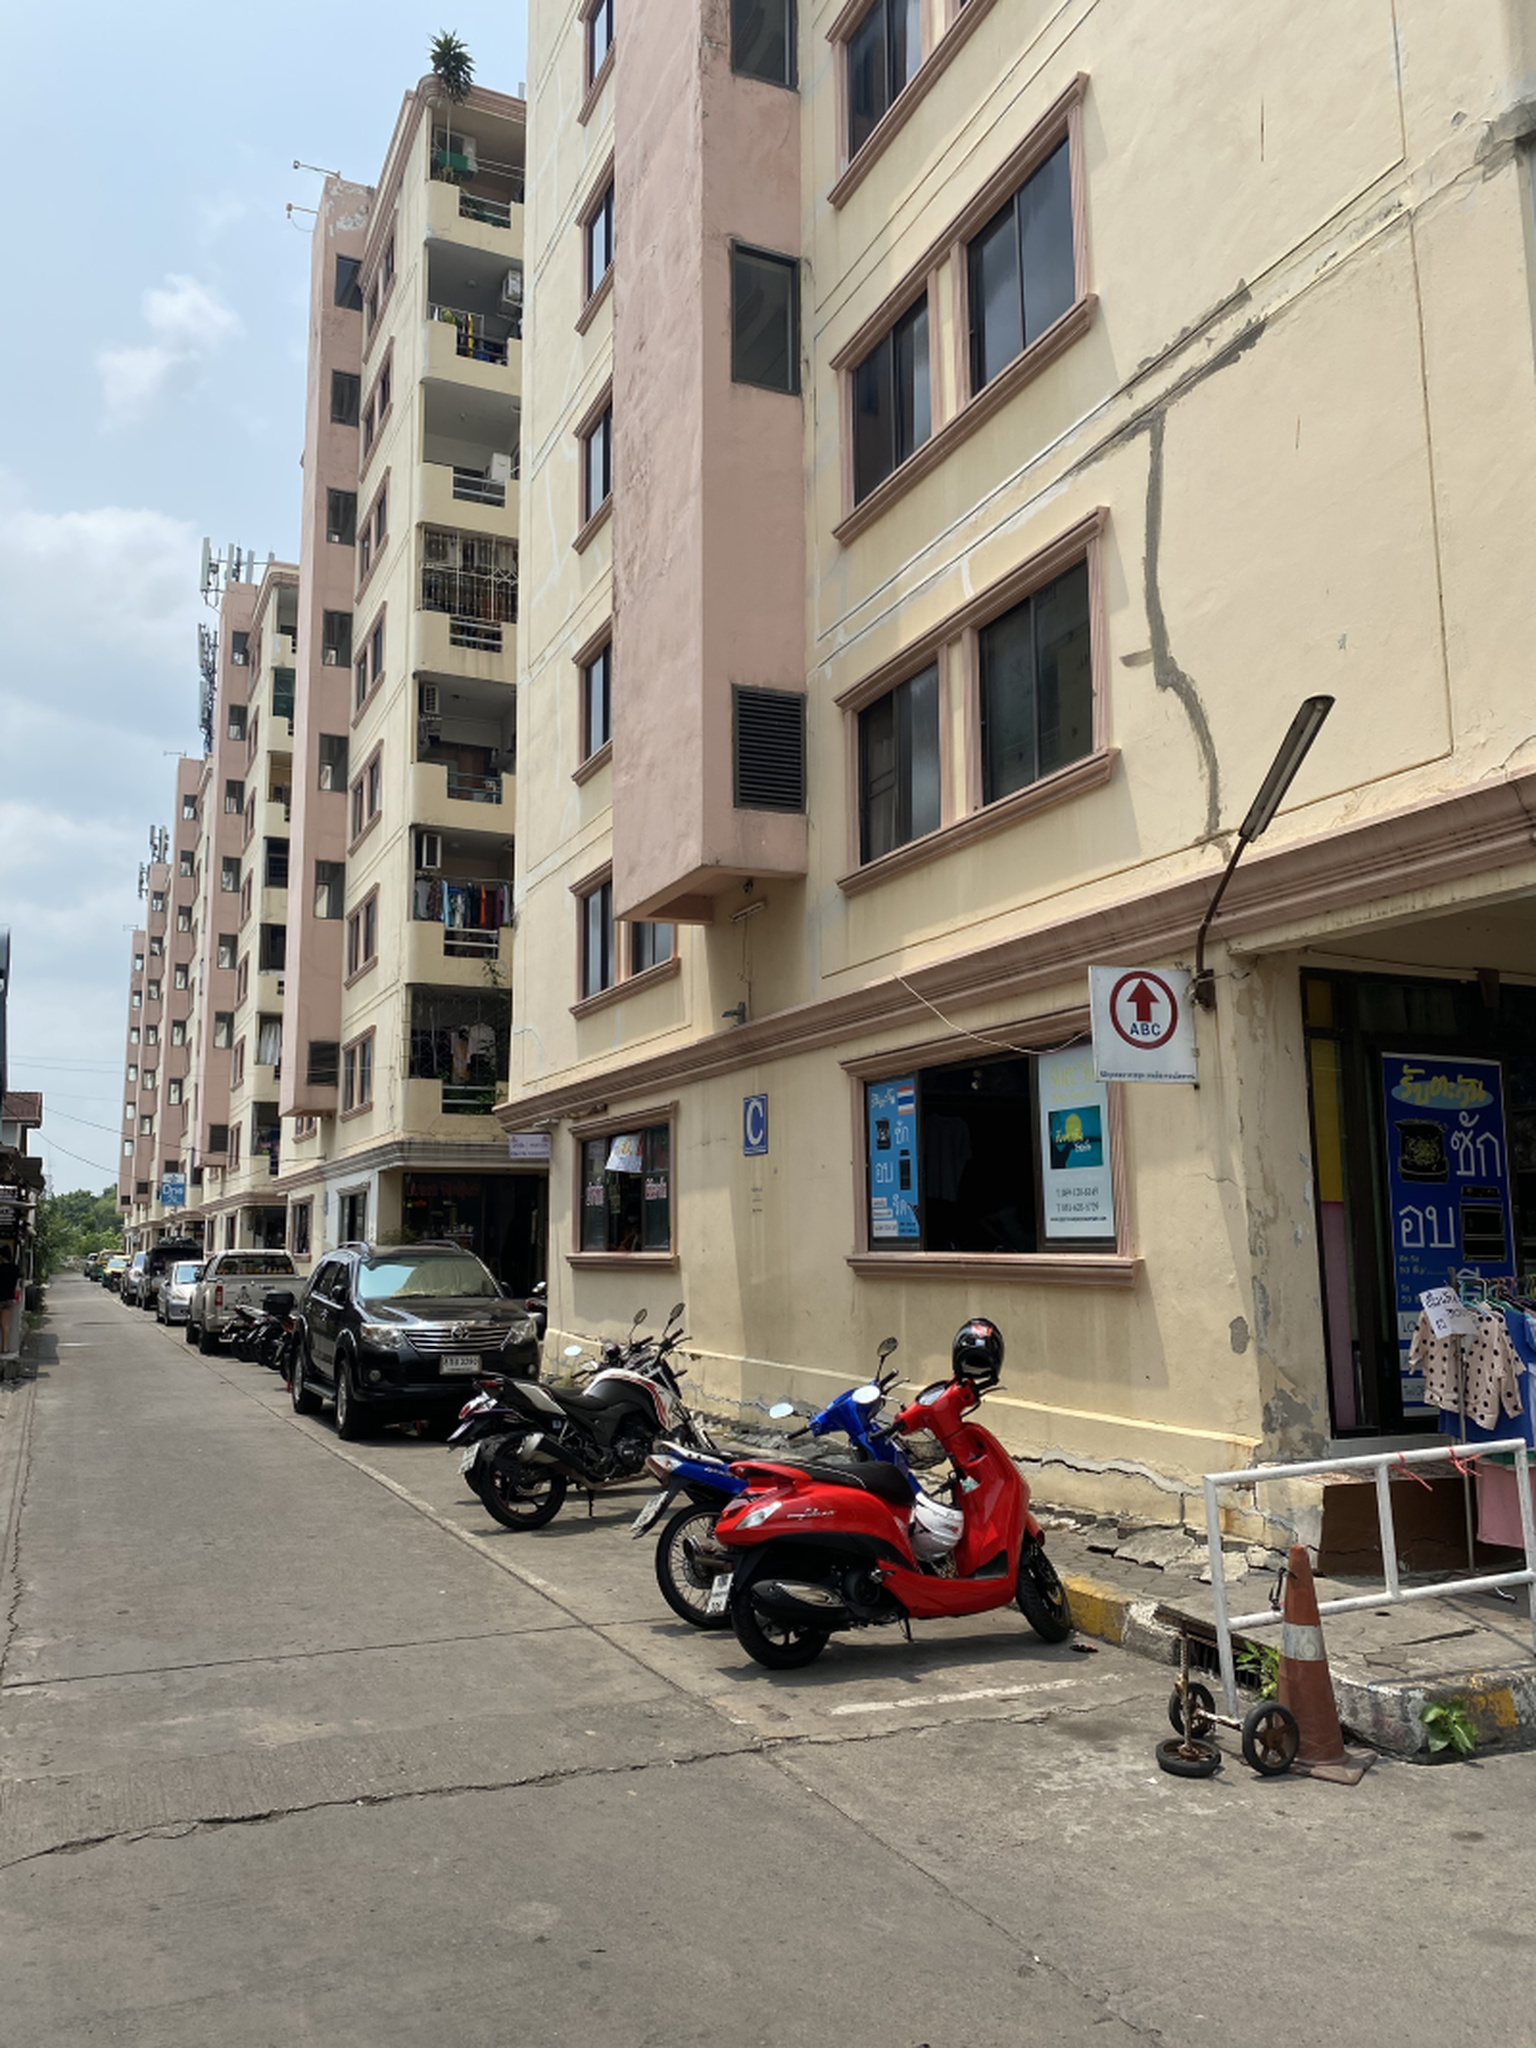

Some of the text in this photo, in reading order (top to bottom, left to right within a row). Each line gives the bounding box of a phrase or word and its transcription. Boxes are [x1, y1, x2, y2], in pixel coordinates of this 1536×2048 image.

[1130, 1022, 1161, 1037] ABC
[746, 1099, 763, 1146] C
[1451, 1111, 1502, 1177] ซัก
[1398, 1204, 1456, 1249] อบ
